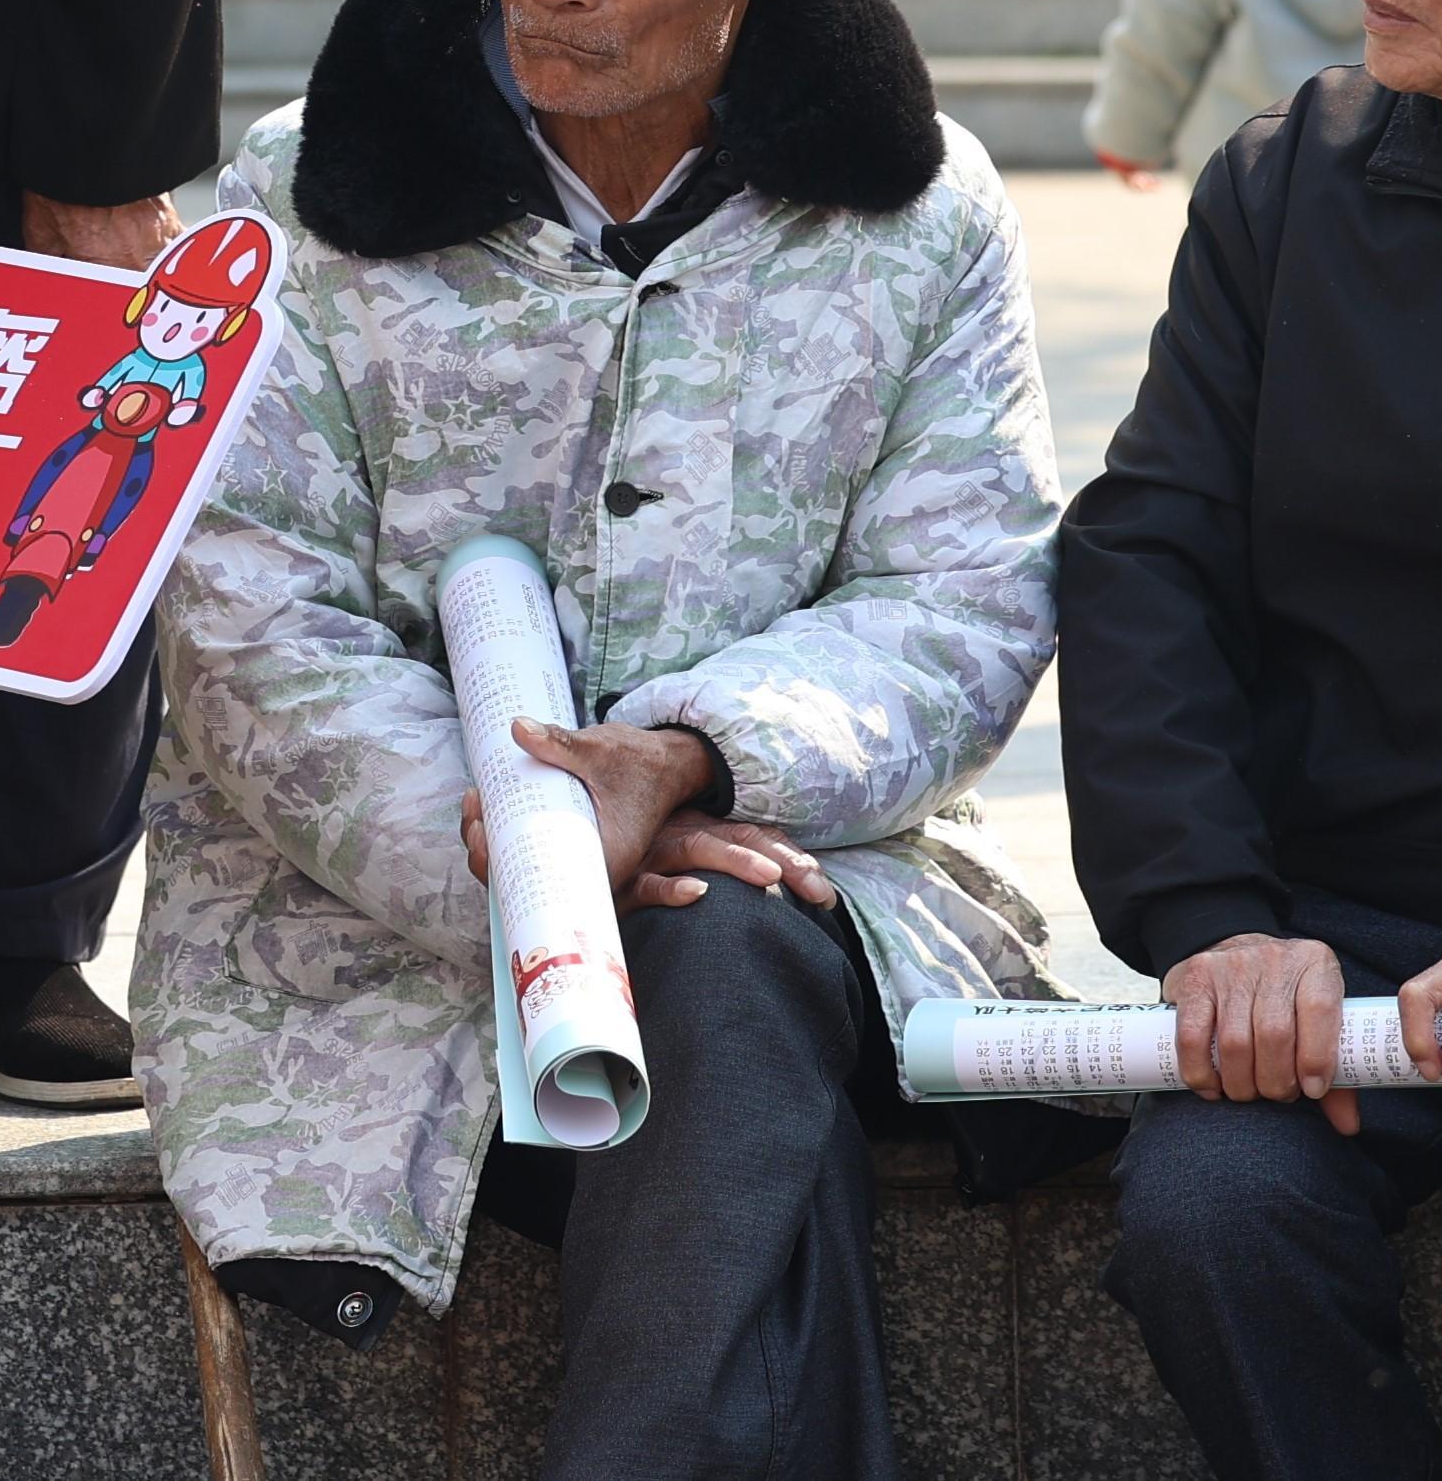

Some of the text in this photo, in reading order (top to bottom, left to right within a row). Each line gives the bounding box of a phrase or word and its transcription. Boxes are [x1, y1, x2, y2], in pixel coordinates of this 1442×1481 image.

[1363, 1018, 1377, 1026] 30
[1021, 1028, 1034, 1037] 31
[1042, 1027, 1057, 1037] 30
[1109, 1025, 1123, 1035] 27
[1341, 1035, 1399, 1045] 22 23 24
[976, 1044, 1122, 1057] 20 21 22 23 24 25 26
[1157, 1042, 1171, 1052] 28
[1342, 1055, 1400, 1065] 15 16 17
[979, 1064, 1124, 1076] 13 14 15 16 17 18 19
[1159, 1062, 1172, 1070] 21
